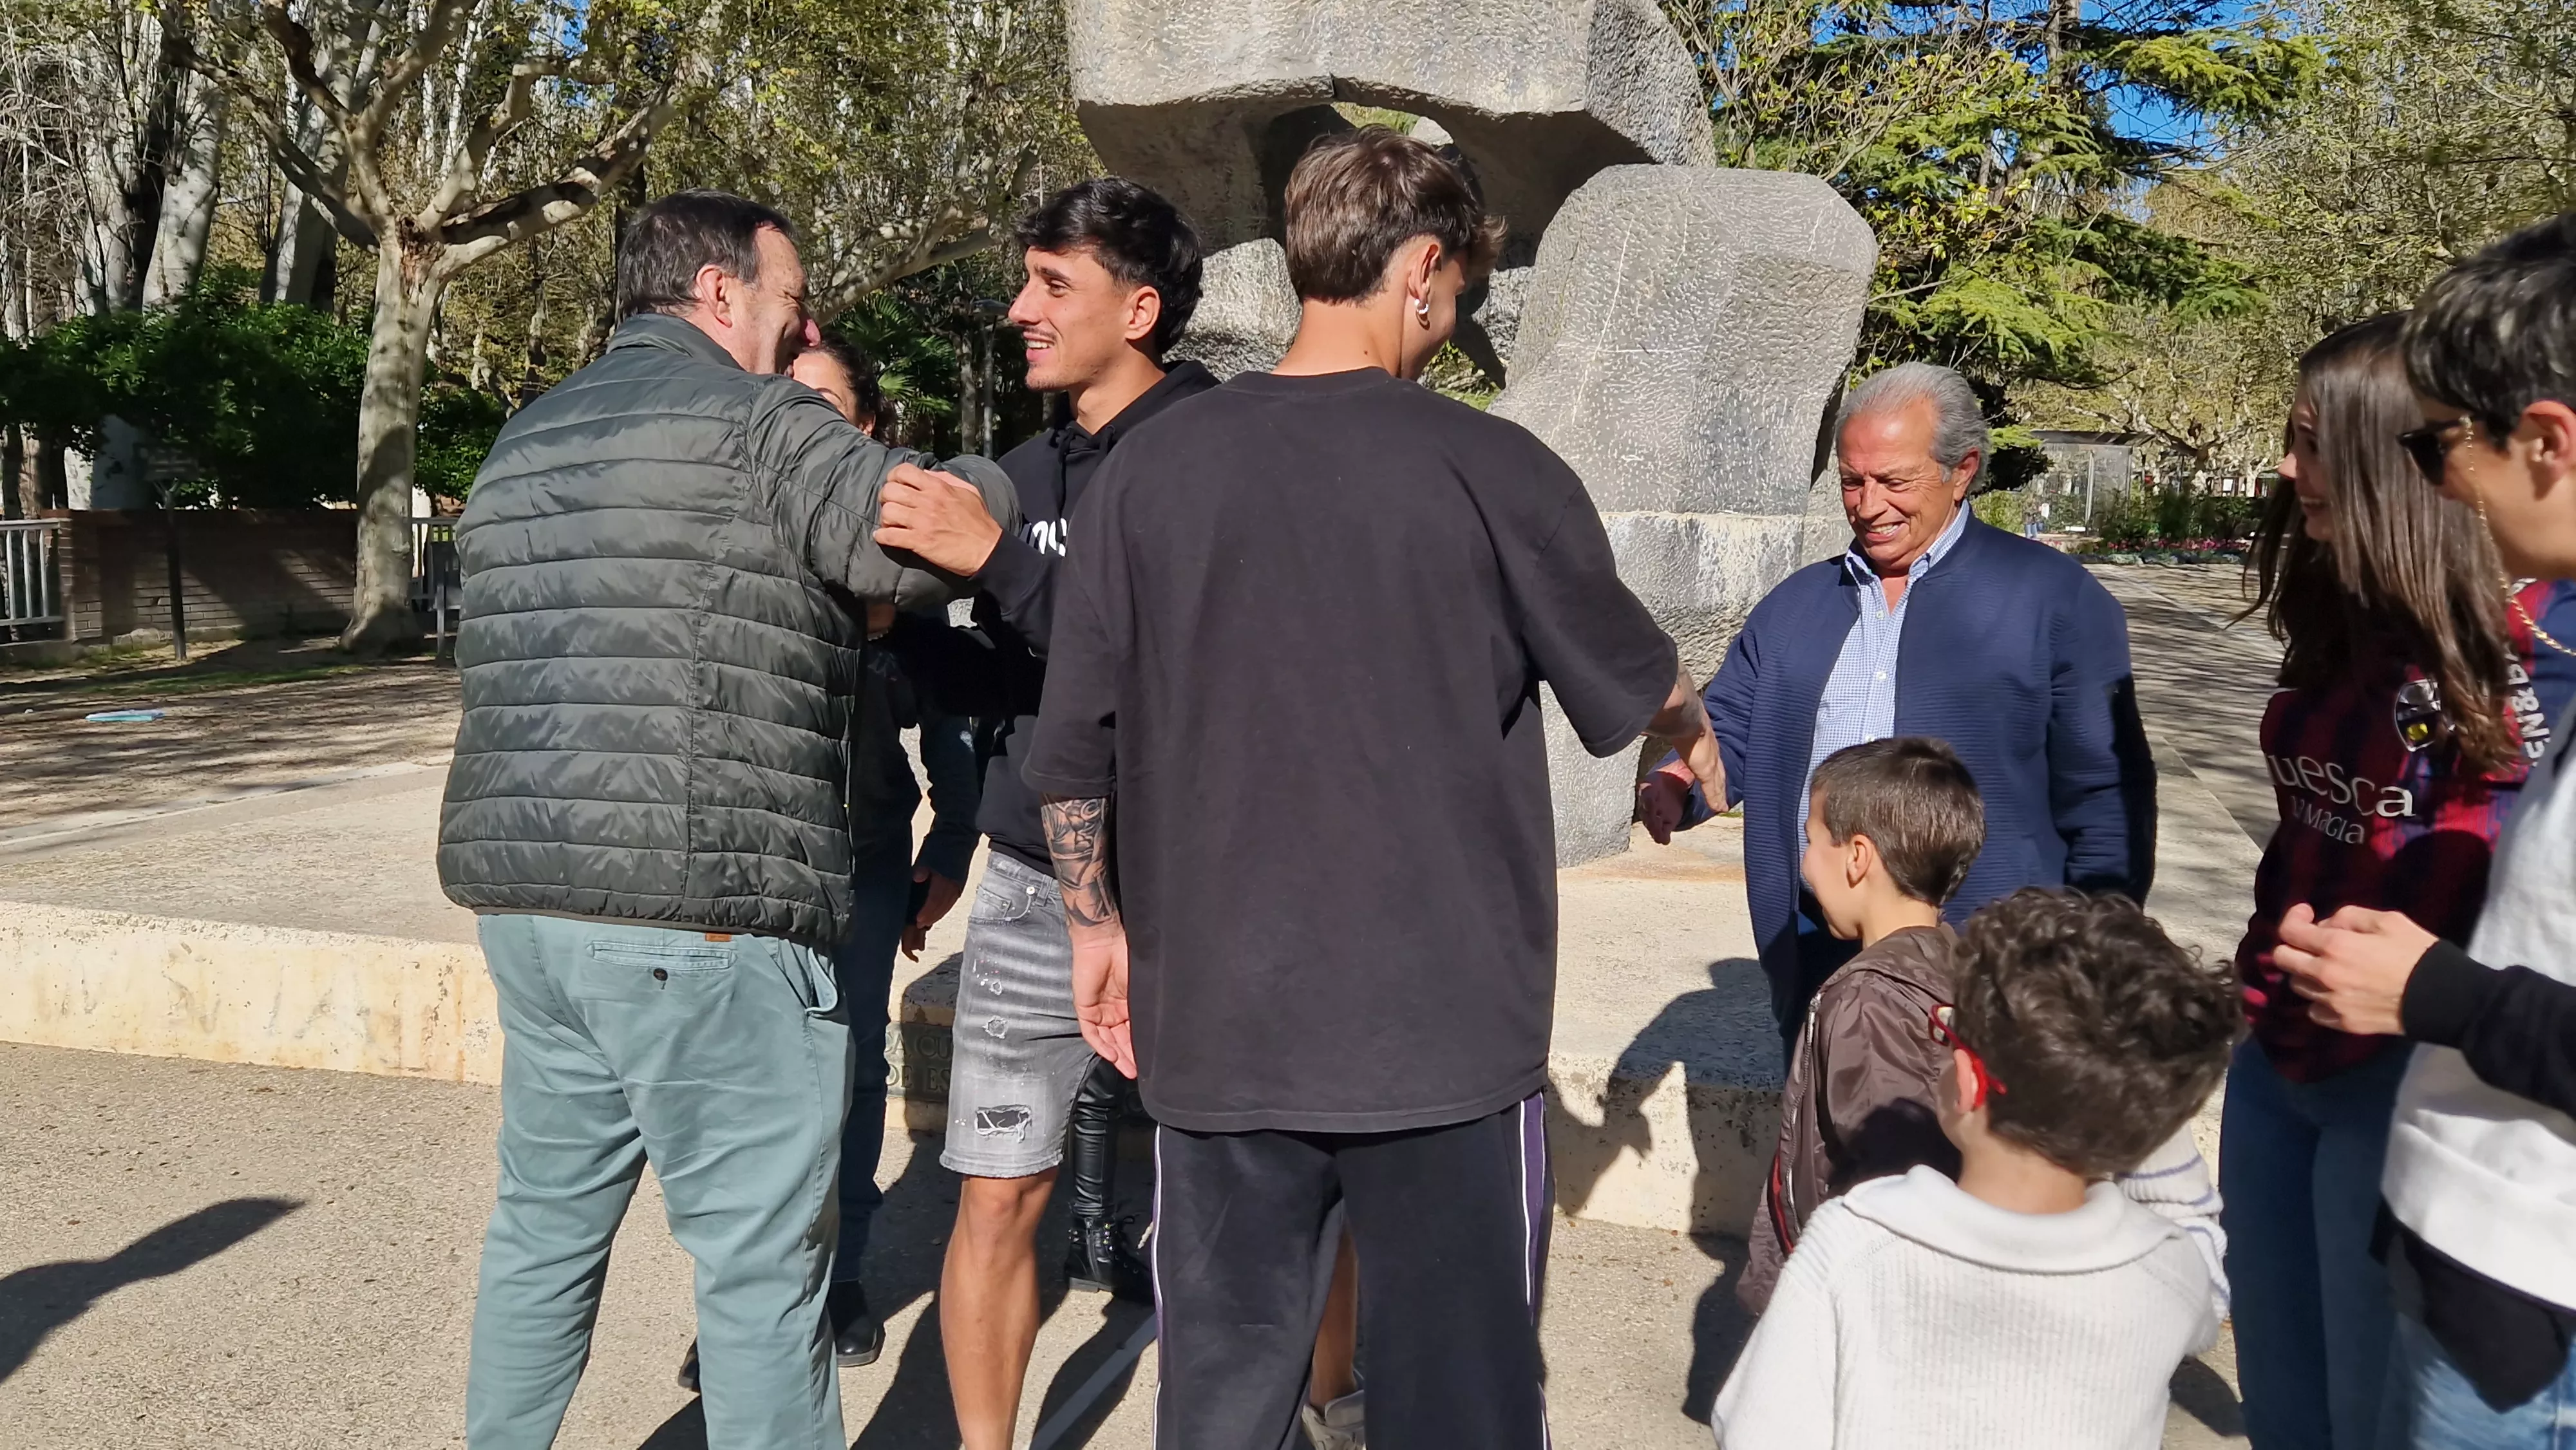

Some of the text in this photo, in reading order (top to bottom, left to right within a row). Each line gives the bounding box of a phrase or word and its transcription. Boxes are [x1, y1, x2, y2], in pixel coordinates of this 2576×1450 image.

[2268, 755, 2416, 817] uesca
[916, 1034, 952, 1060] CU
[927, 1067, 951, 1093] ES
